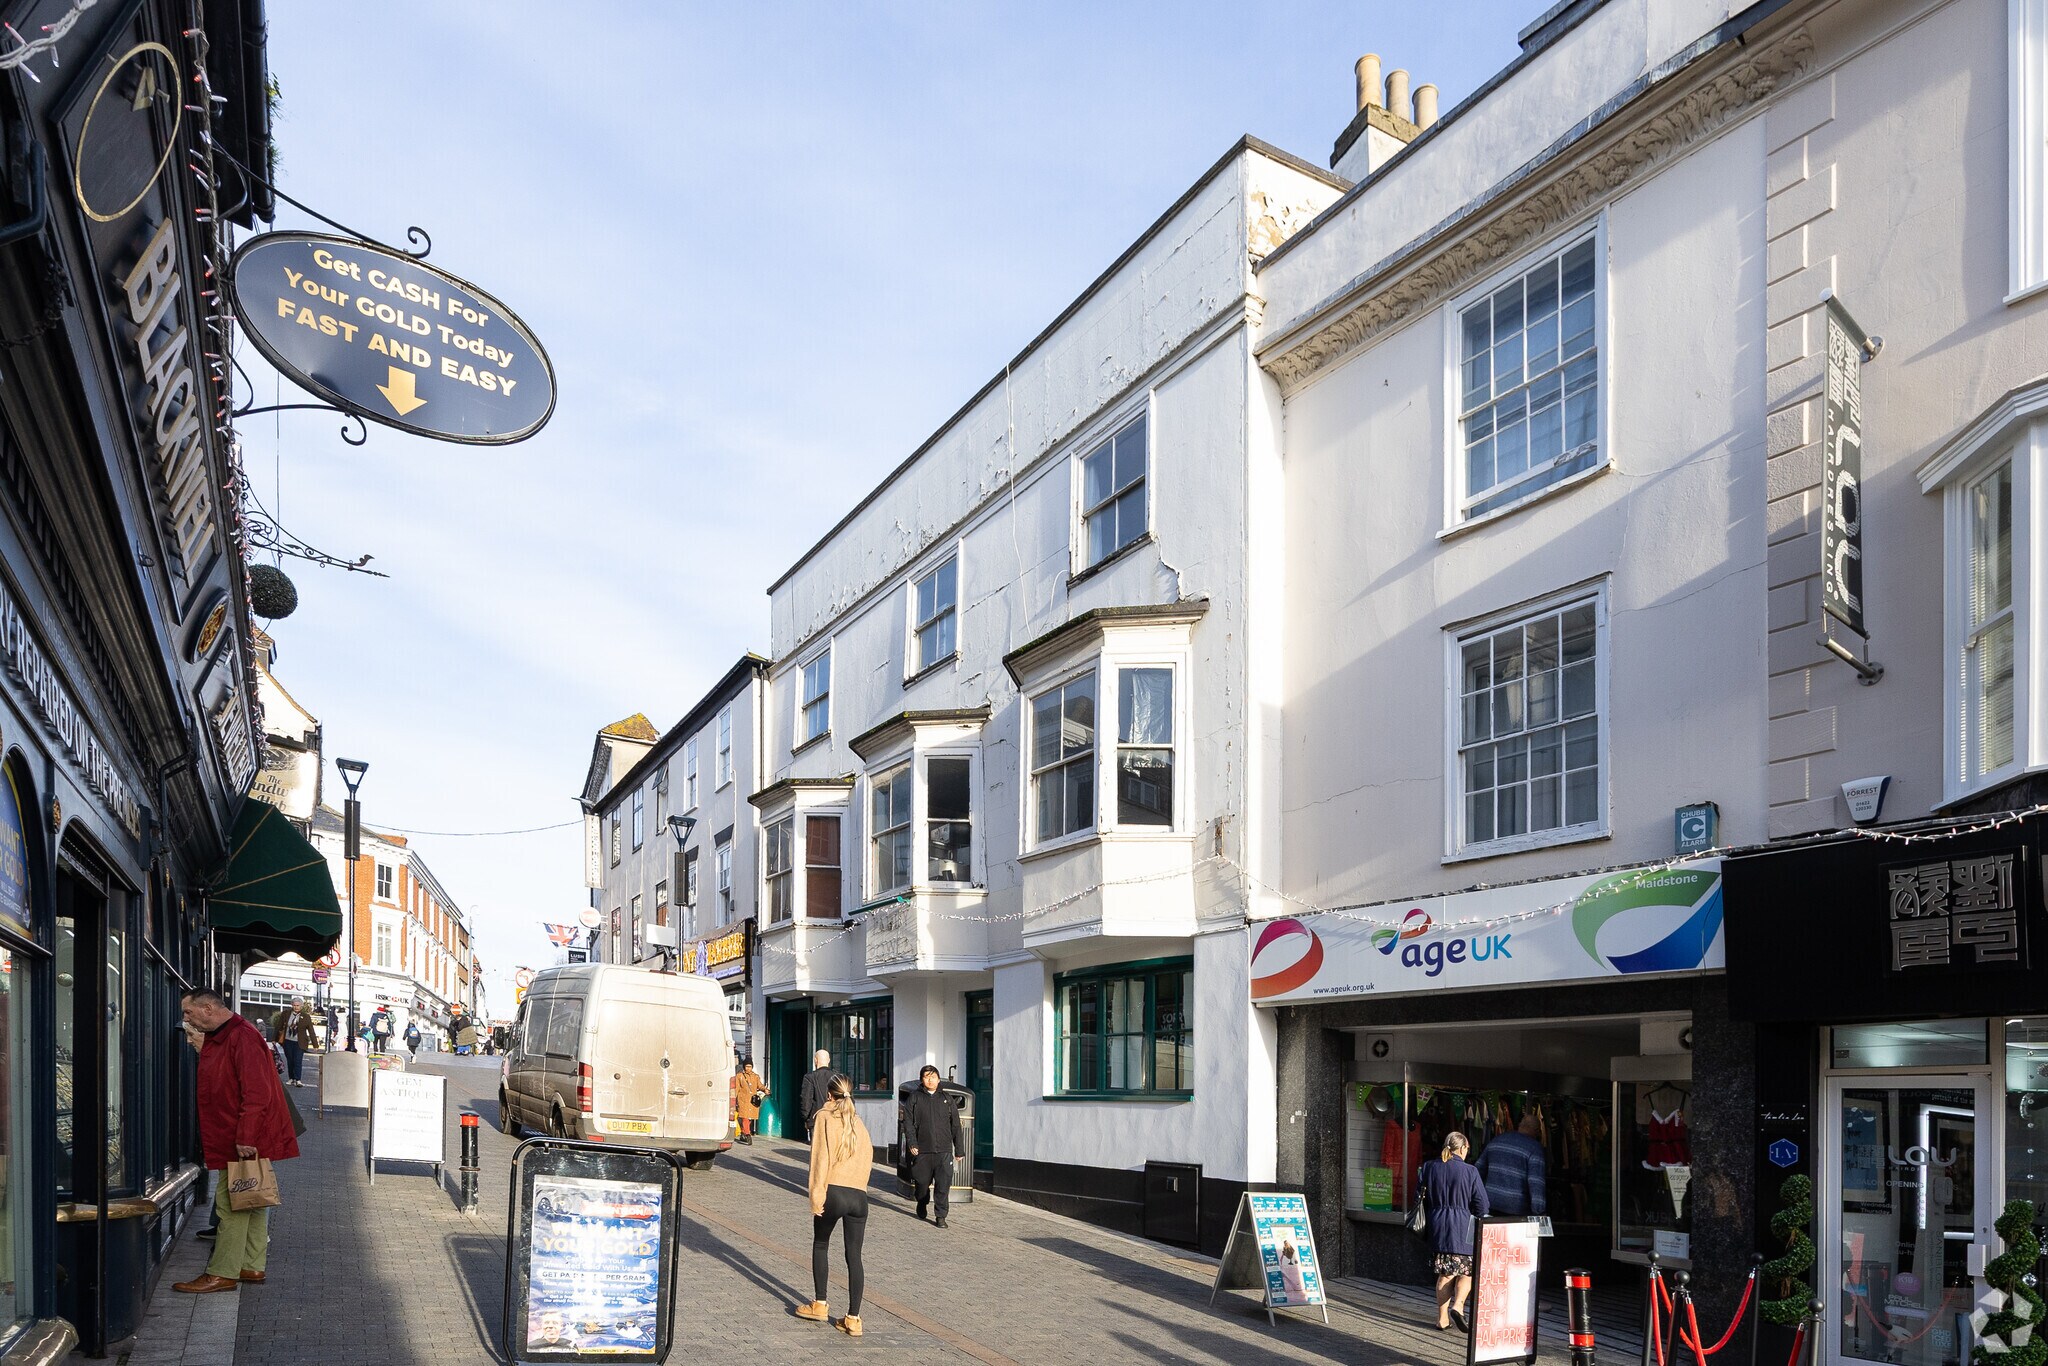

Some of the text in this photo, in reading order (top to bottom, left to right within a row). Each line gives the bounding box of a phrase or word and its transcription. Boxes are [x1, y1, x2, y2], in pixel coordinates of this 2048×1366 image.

[313, 249, 489, 327] Get CASH For
[283, 266, 514, 368] Your GOLD Today
[277, 297, 517, 397] FAST AND EASY
[122, 216, 215, 590] BLACKWELL
[1825, 407, 1836, 601] HAIRDRESSING
[16, 613, 73, 749] REPAIRED
[75, 713, 90, 774] ON
[90, 735, 108, 799] THE
[213, 686, 253, 798] JEWELLERS
[267, 774, 283, 785] The
[1846, 787, 1878, 797] FORREST
[1681, 809, 1706, 818] CHUBB
[1681, 839, 1706, 847] ALARM
[1636, 873, 1699, 890] Maidstone
[1401, 934, 1513, 977] age UK
[253, 979, 311, 992] HSBC UK
[1313, 982, 1375, 995] www.ageuk.org.uk
[375, 993, 391, 1002] HSBC
[397, 1077, 422, 1087] GEM
[1860, 1201, 1897, 1209] Wednesday
[1860, 1207, 1890, 1216] Thursday
[1482, 1227, 1507, 1244] PAUL
[603, 1242, 652, 1256] GOLD
[1480, 1247, 1530, 1265] MITCHELL
[1479, 1268, 1508, 1286] SALE!
[1478, 1288, 1500, 1306] BUY
[1477, 1309, 1499, 1327] GET
